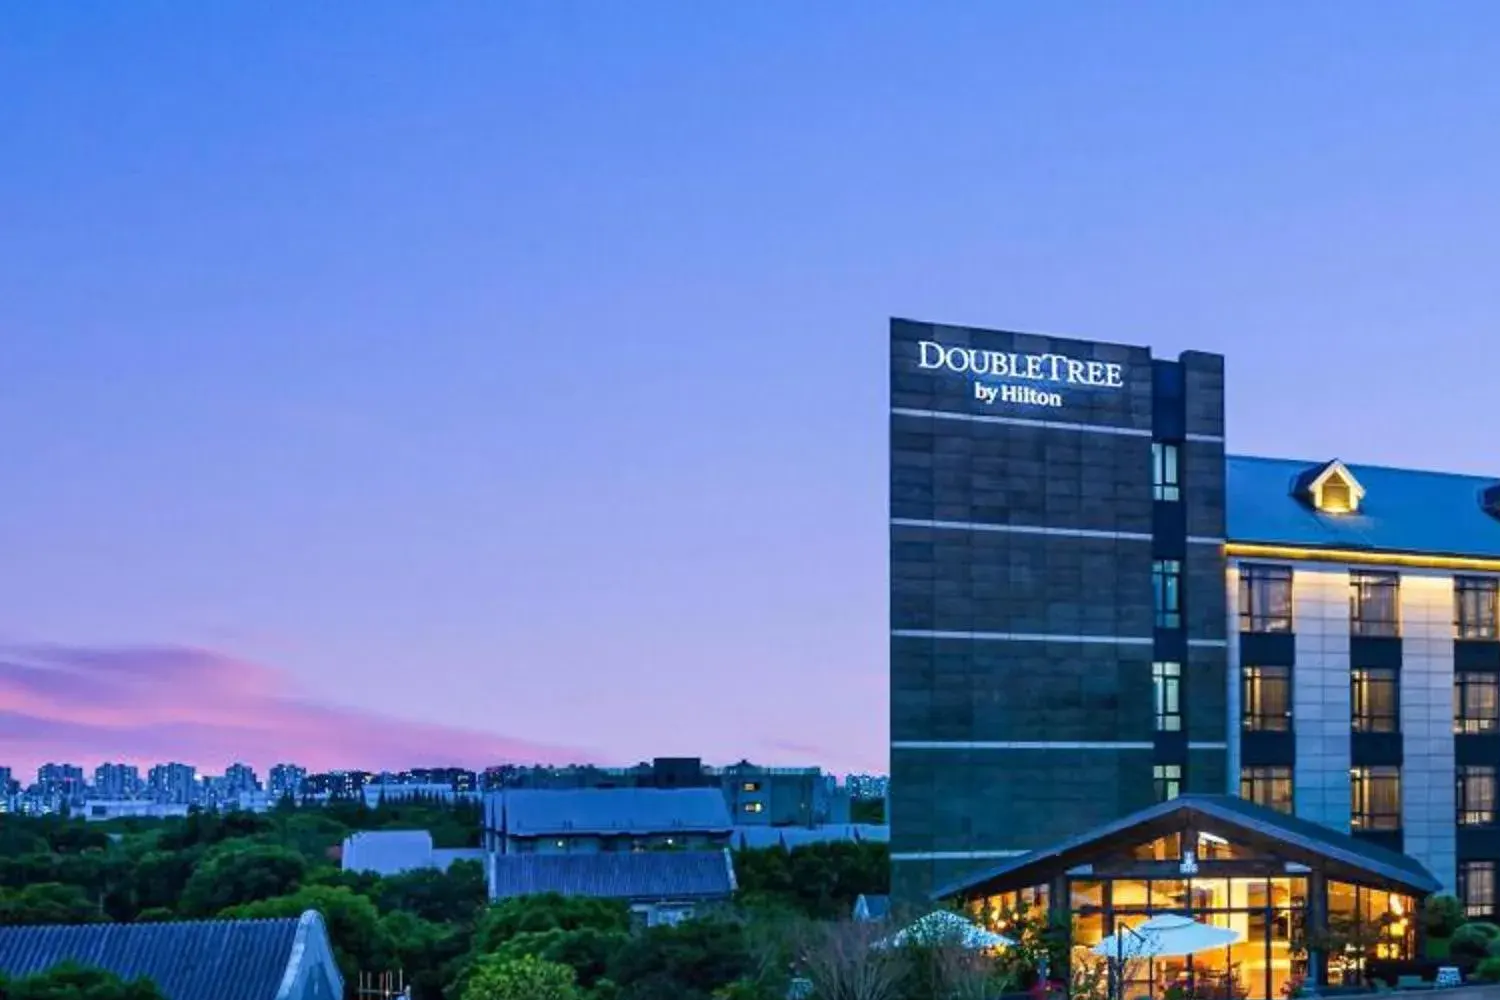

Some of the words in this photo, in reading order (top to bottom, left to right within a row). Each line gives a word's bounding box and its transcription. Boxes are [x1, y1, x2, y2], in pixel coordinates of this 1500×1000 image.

[917, 341, 1123, 387] DOUBLETREE
[975, 382, 998, 404] by
[1001, 384, 1062, 407] Hilton
